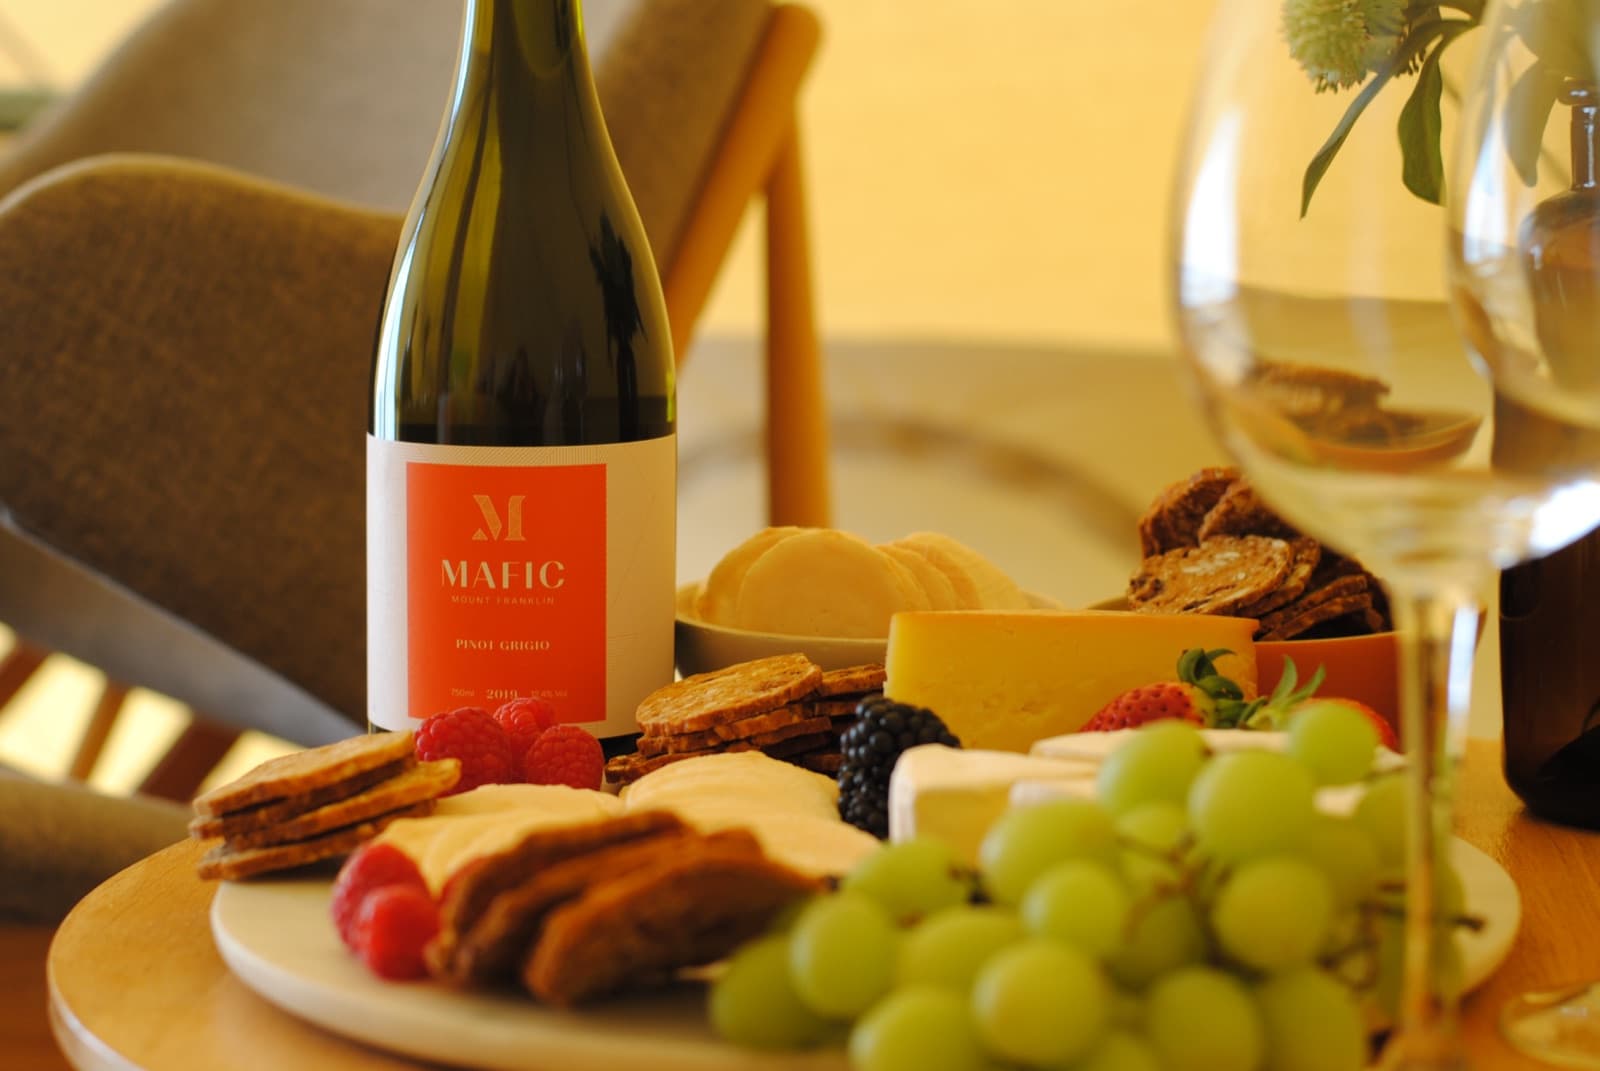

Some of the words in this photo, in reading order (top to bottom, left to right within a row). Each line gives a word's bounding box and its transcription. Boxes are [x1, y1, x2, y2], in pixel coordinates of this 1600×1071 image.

[472, 495, 526, 541] M
[441, 559, 565, 589] MAFIC
[451, 595, 490, 605] MOUNT
[497, 596, 554, 605] FRANKLIN
[456, 639, 494, 650] PINOT
[499, 640, 550, 651] GRIGIO
[486, 689, 518, 700] 2019
